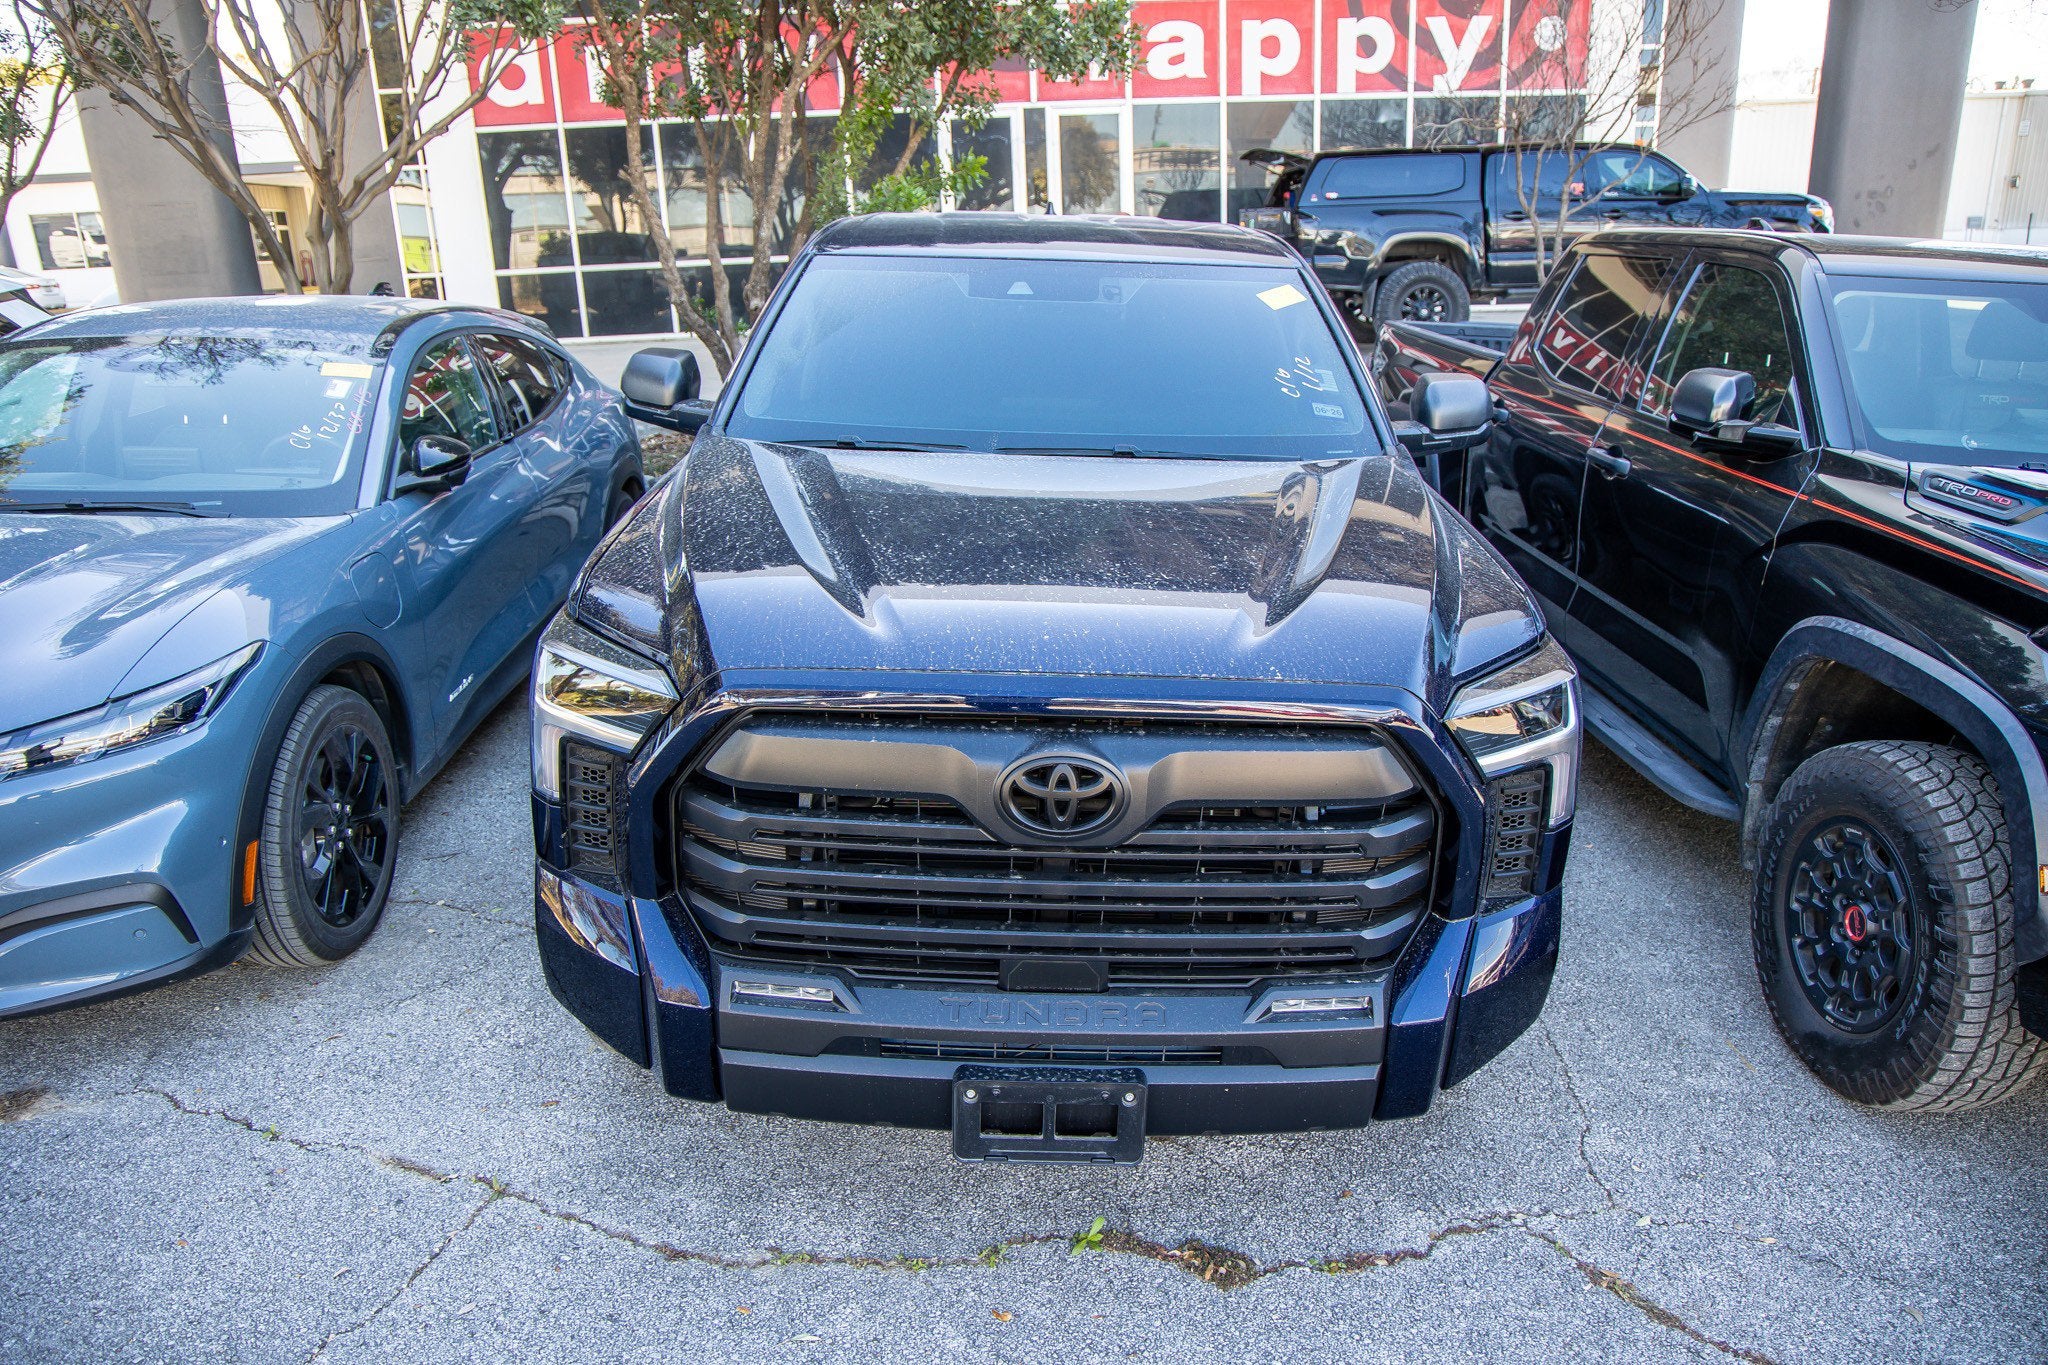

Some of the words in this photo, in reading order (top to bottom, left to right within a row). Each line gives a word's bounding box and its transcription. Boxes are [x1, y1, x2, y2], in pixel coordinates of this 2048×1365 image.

[1054, 3, 1493, 95] appy
[1979, 394, 2010, 405] TRD
[938, 997, 1168, 1029] TUNDRA
